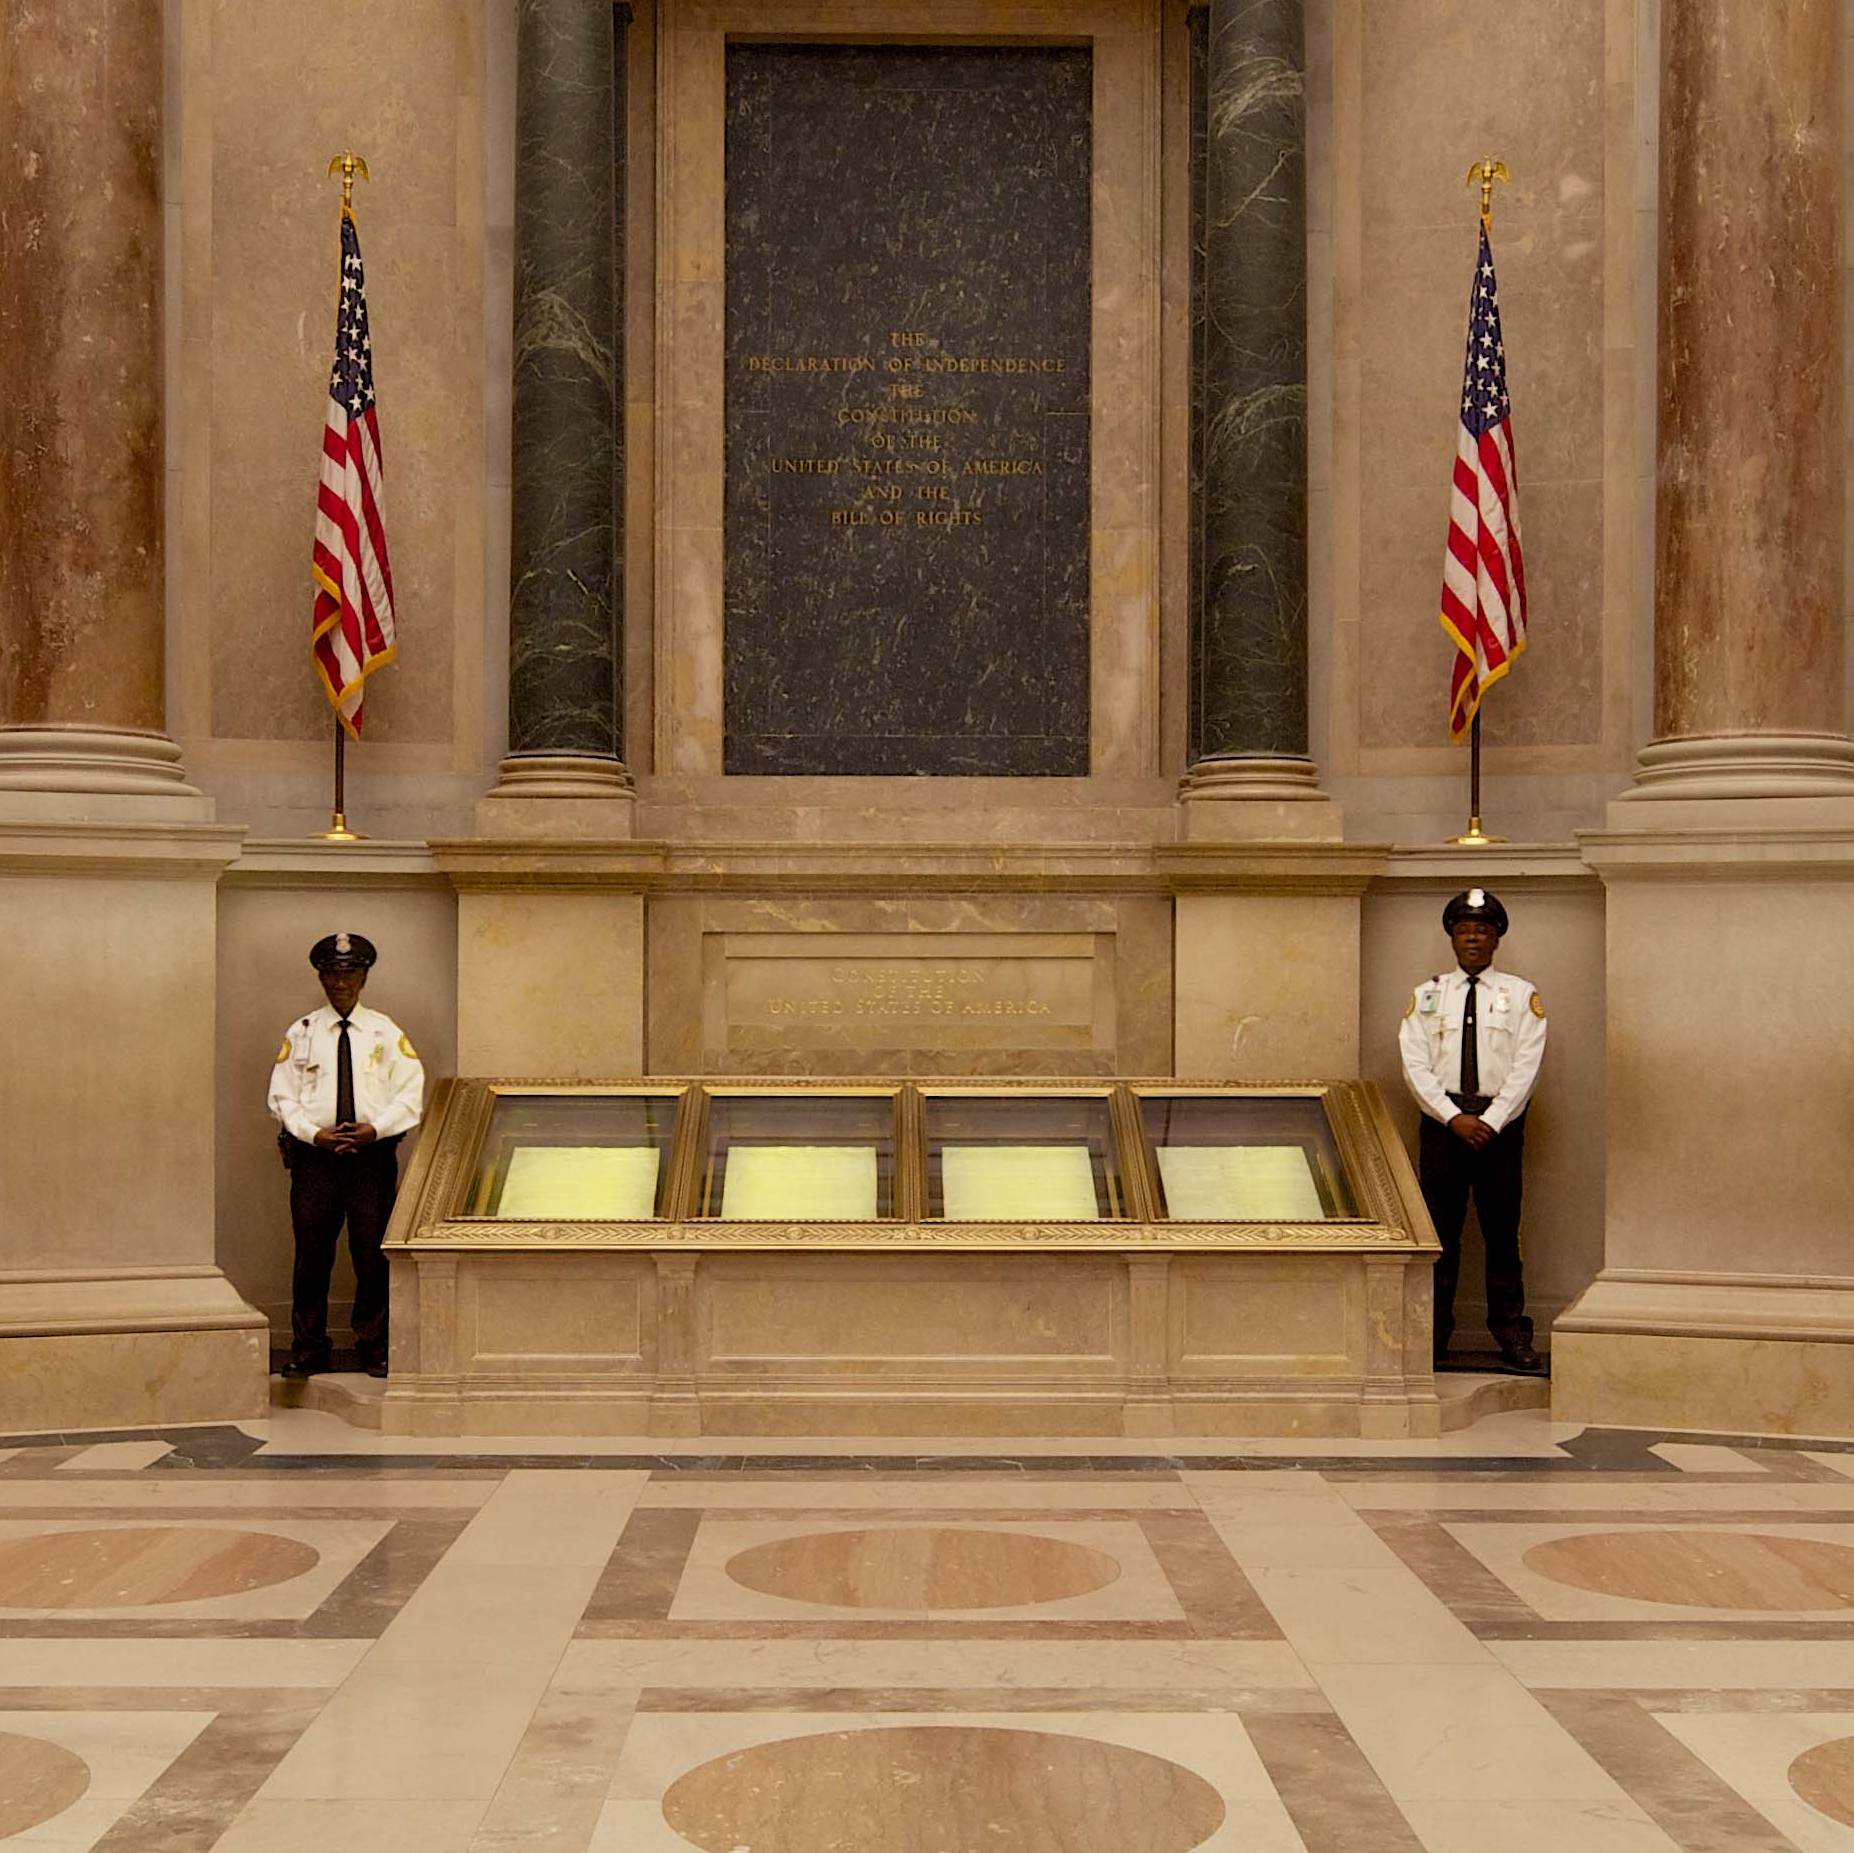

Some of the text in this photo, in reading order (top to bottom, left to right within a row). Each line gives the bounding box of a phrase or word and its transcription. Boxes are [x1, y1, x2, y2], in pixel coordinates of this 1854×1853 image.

[890, 332, 924, 346] THE
[749, 358, 1066, 373] DECLARATION OF INDEPENDENCE
[889, 384, 924, 397] THE
[838, 409, 978, 424] CONSTITUTION
[871, 435, 940, 448] OF THE
[771, 460, 1043, 475] UNITED STATES OF AMERICA
[863, 485, 948, 499] AND THE
[831, 511, 981, 527] BILL OF RIGHTS
[832, 968, 986, 984] CONSTITUTION
[874, 985, 945, 998] OF THE
[769, 999, 1052, 1014] UNITED STATES OF AMERICA
